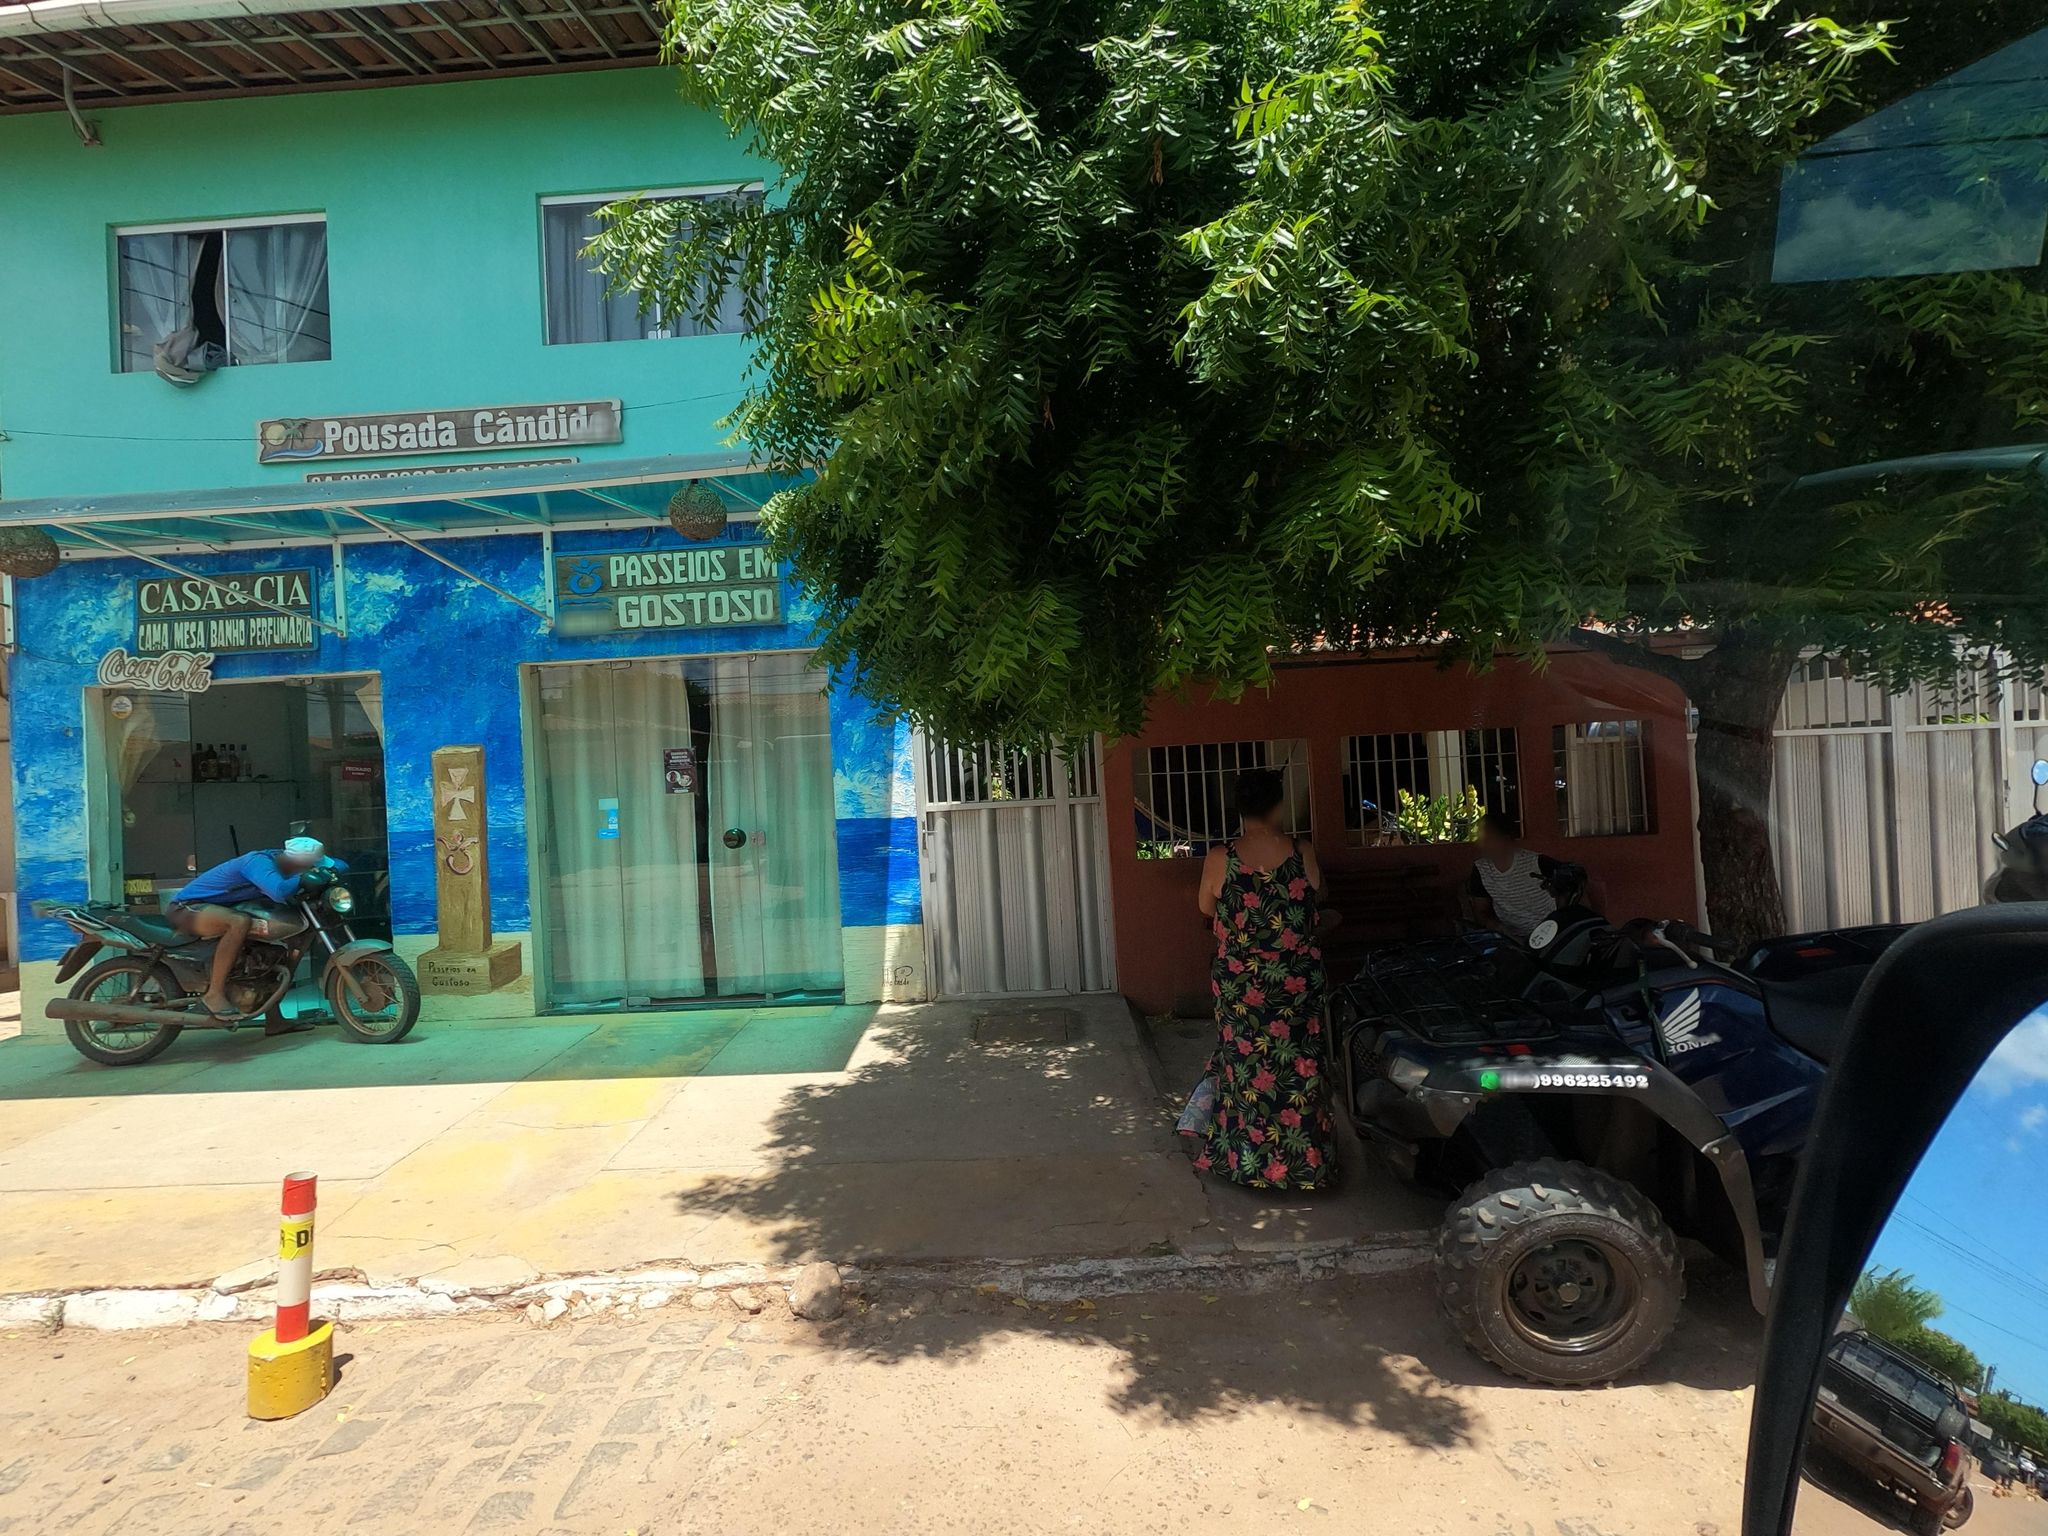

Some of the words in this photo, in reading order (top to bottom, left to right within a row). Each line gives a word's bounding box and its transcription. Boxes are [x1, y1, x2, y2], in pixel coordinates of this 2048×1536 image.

[323, 415, 457, 454] Pousada
[473, 405, 614, 446] Cândid
[610, 550, 726, 587] PASSEIOS
[738, 546, 778, 580] EM
[140, 576, 310, 614] CASA&CIA
[618, 589, 773, 628] GOSTOSO
[138, 623, 169, 651] CAMA
[173, 621, 205, 649] MESA
[210, 618, 246, 647] BANHO
[249, 615, 313, 648] PERFUMARIA
